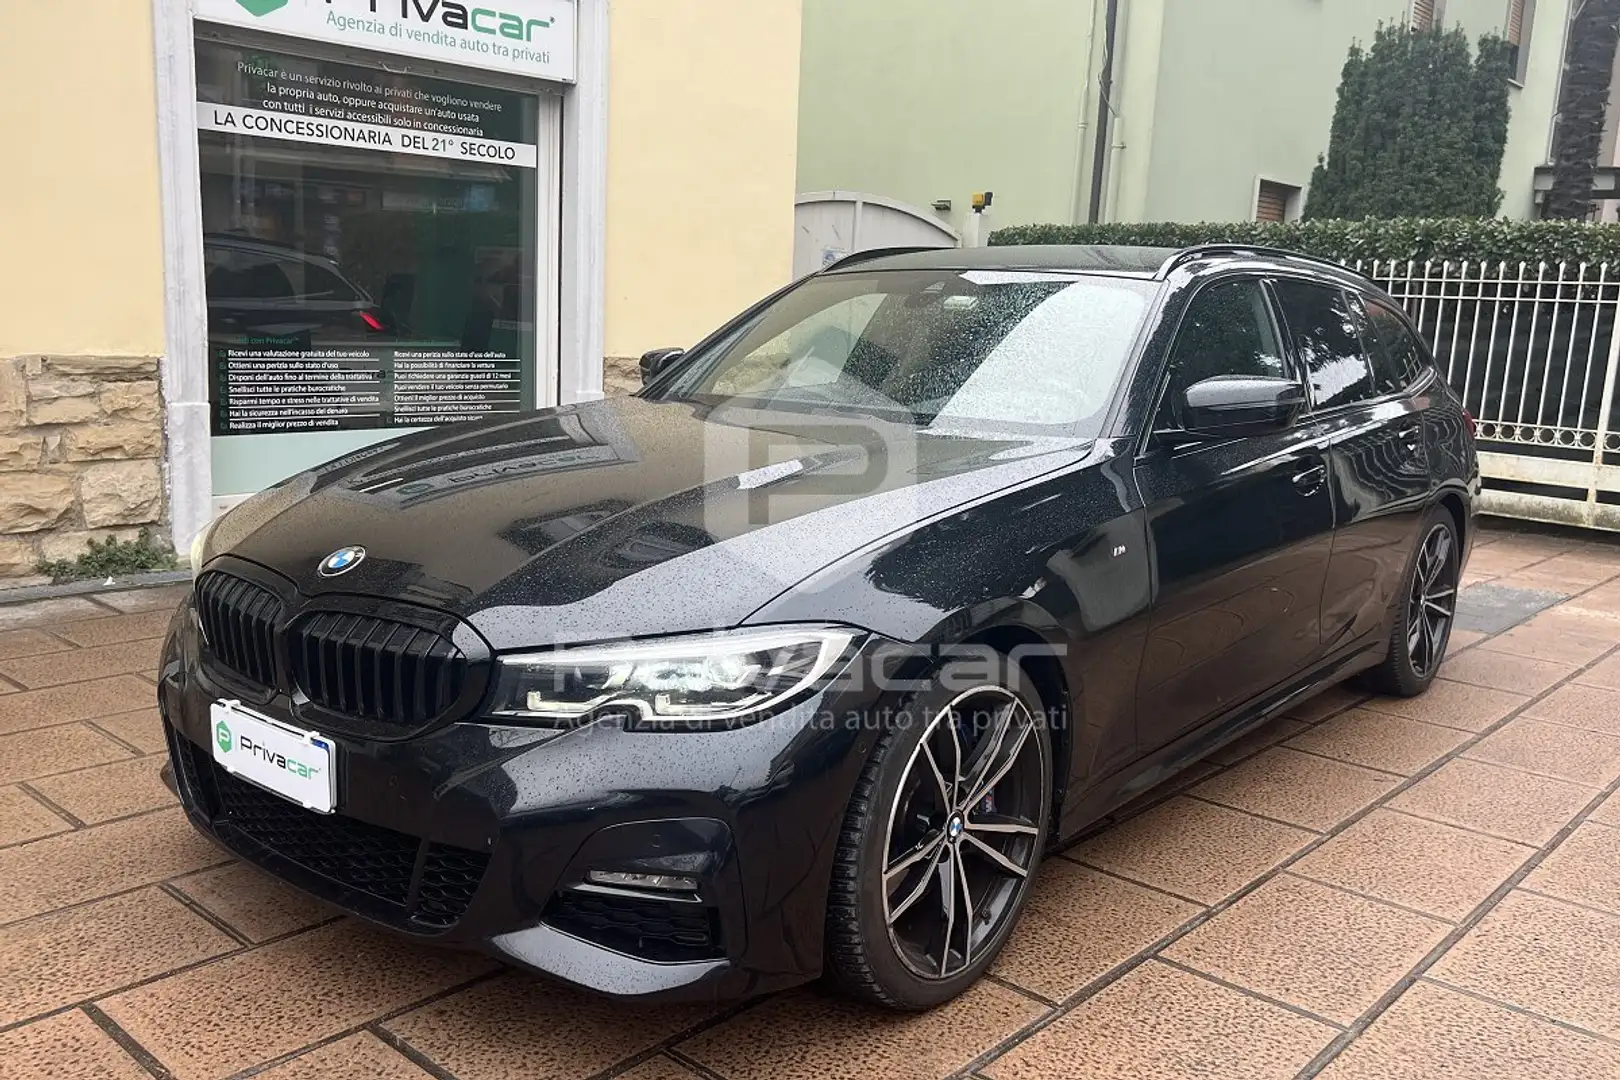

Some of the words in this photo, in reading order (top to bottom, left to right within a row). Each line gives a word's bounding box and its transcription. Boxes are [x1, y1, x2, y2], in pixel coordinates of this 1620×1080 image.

[326, 10, 385, 34] Agenzia
[389, 22, 402, 38] di
[406, 27, 456, 47] vendita
[460, 38, 488, 52] auto
[493, 44, 508, 56] tra
[512, 47, 550, 64] privati
[238, 62, 278, 78] Privacar
[288, 74, 302, 82] un
[305, 75, 341, 88] servizio
[343, 80, 372, 92] rivolto
[374, 85, 382, 94] ai
[384, 86, 412, 98] privati
[414, 90, 430, 100] che
[431, 94, 468, 107] vogliono
[470, 99, 502, 112] vendere
[267, 82, 276, 94] la
[279, 84, 315, 99] propria
[317, 92, 340, 104] auto,
[342, 96, 376, 108] oppure
[378, 100, 423, 115] acquistare
[458, 112, 480, 122] usata
[214, 110, 236, 127] LA
[242, 114, 392, 146] CONCESSIONARIA
[401, 134, 428, 150] DEL
[460, 142, 516, 160] SECOLO
[262, 100, 282, 110] con
[284, 102, 305, 114] tutti
[310, 104, 313, 114] i
[314, 106, 344, 118] servizi
[346, 111, 392, 124] accessibili
[393, 116, 412, 127] solo
[413, 118, 422, 128] in
[423, 120, 484, 136] concessionaria
[240, 735, 319, 780] Privacar
